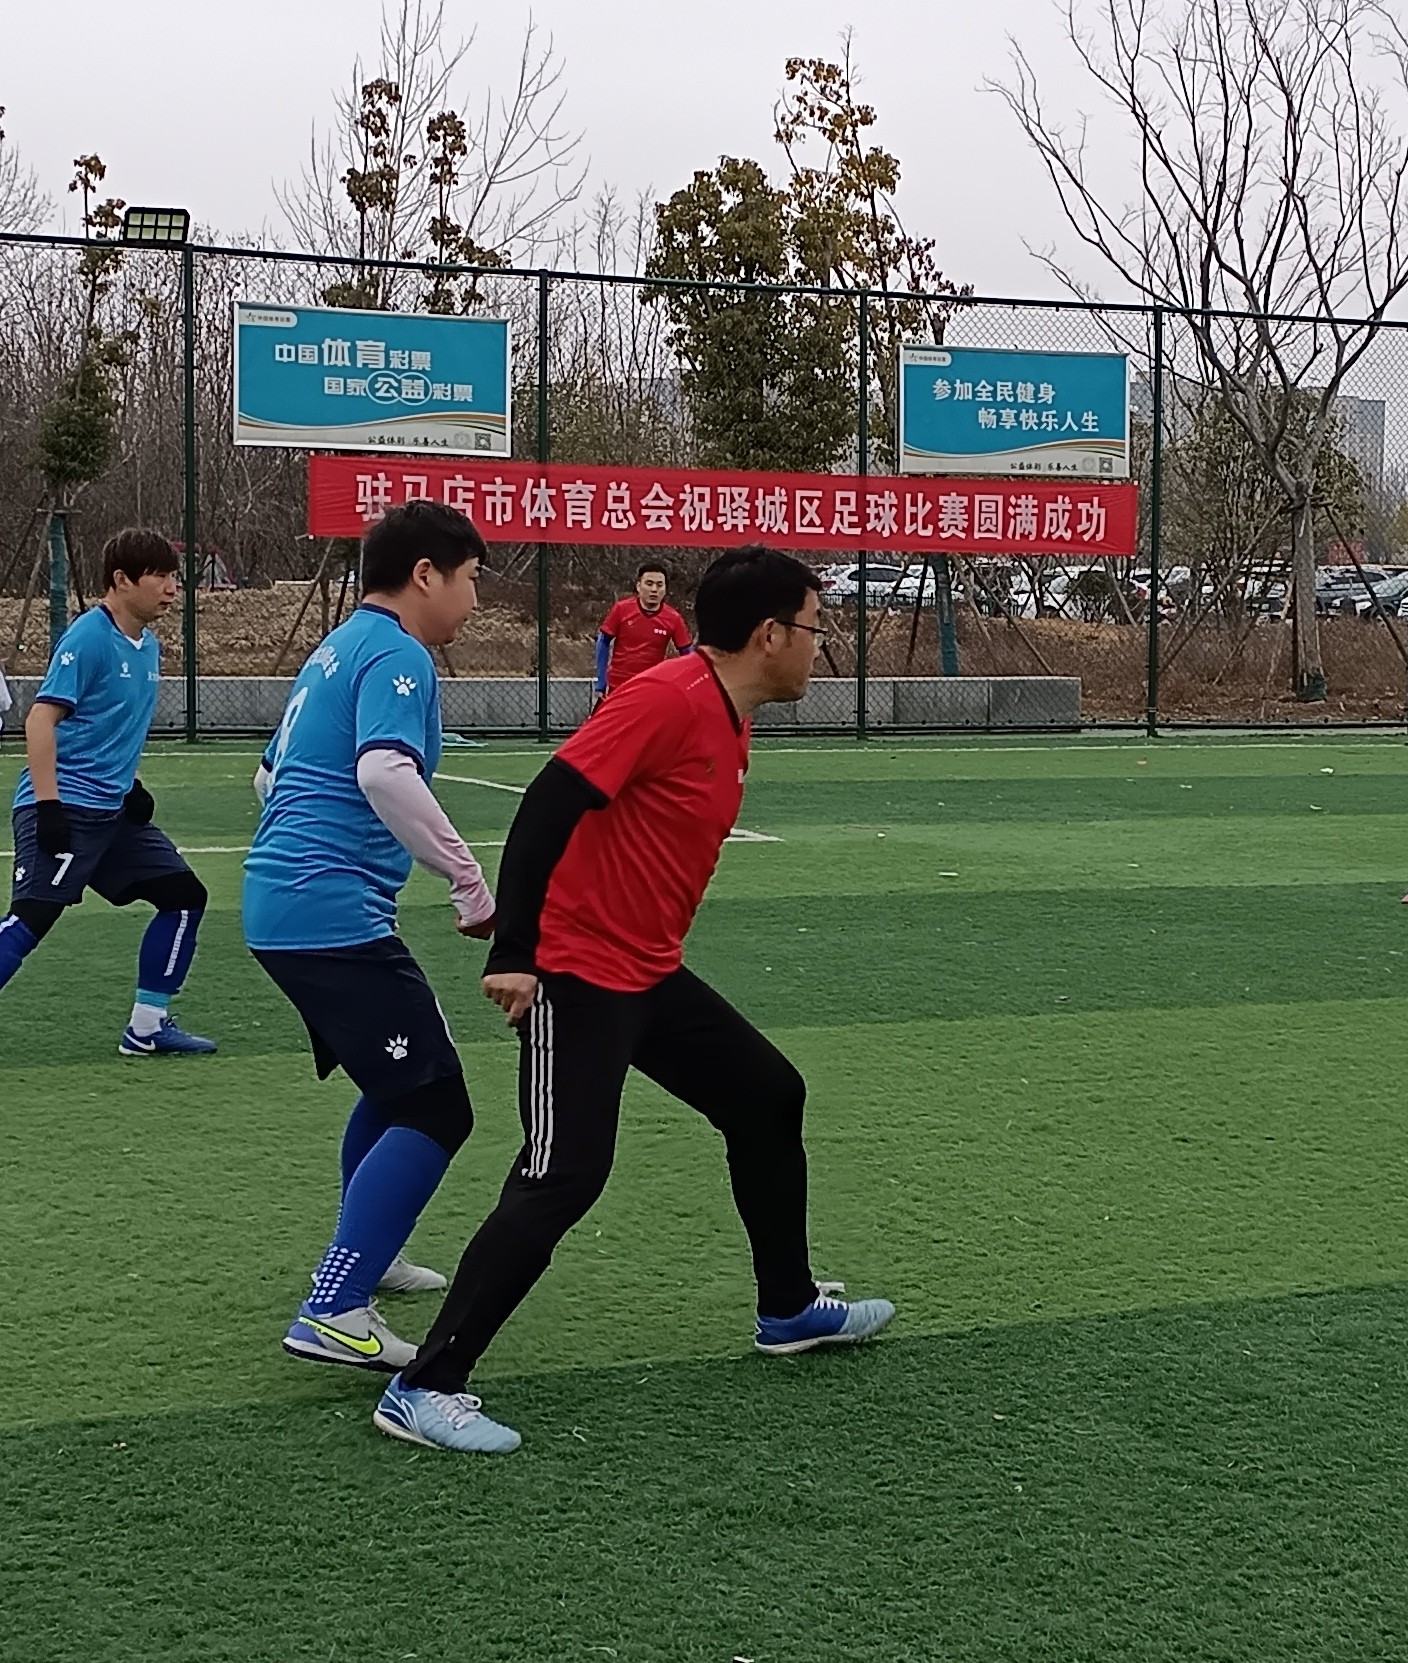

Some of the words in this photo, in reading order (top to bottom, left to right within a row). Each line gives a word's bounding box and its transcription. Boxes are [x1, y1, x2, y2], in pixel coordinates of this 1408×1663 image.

[274, 337, 432, 371] 中国体育彩票
[323, 374, 474, 403] 国家公益彩票
[932, 378, 1056, 405] 参加全民健身
[977, 406, 1100, 432] 畅享快乐人生
[51, 852, 74, 886] 7
